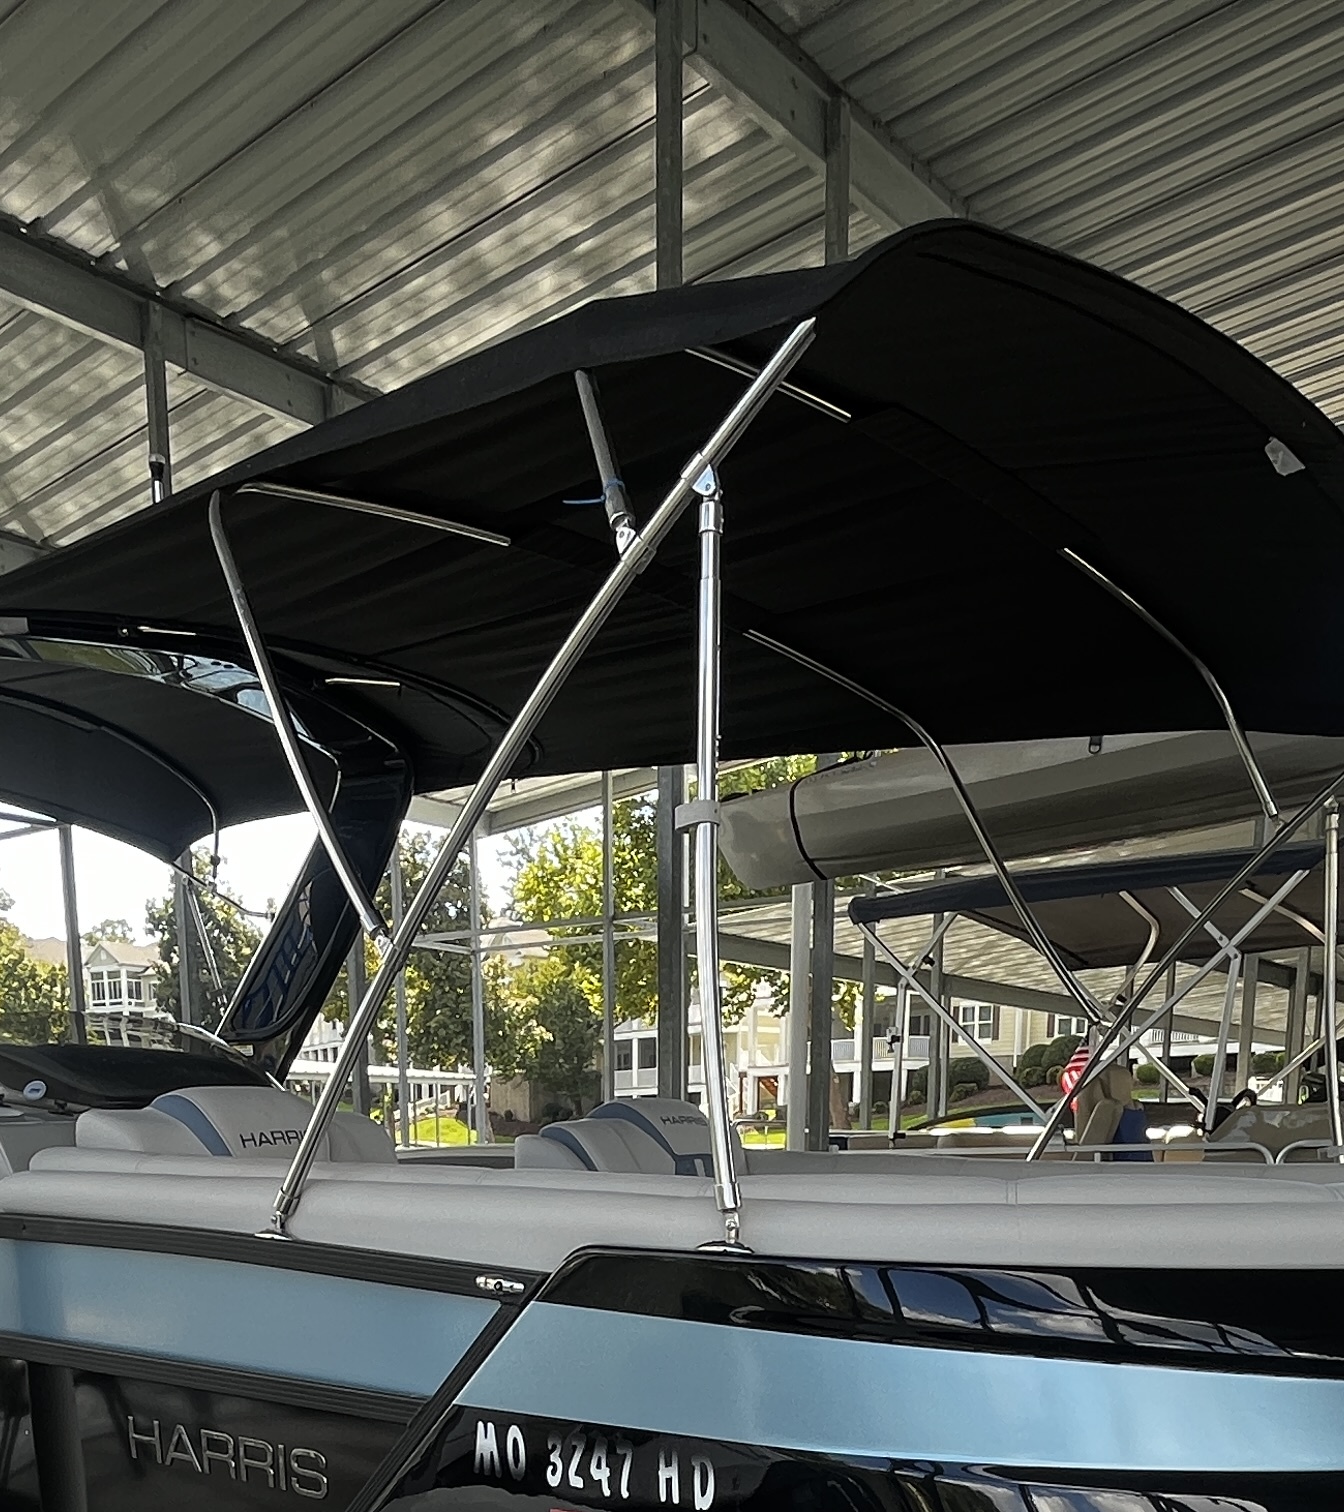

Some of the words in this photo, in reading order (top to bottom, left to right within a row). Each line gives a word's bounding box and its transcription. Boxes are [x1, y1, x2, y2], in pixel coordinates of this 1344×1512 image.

[240, 1129, 308, 1149] HARRI
[125, 1415, 329, 1500] HARRIS
[474, 1419, 528, 1483] MO
[545, 1434, 633, 1499] 3247
